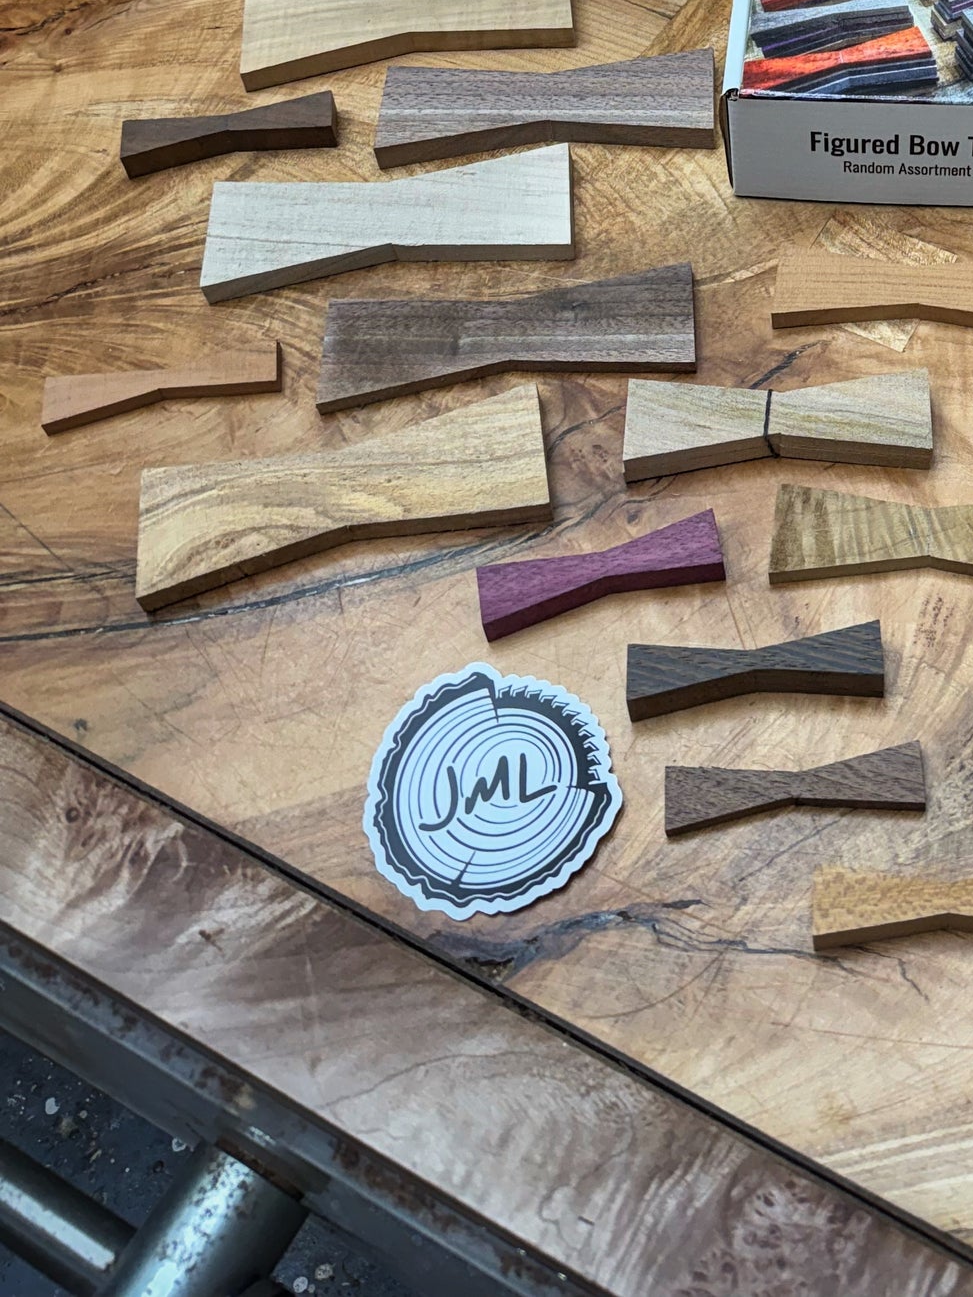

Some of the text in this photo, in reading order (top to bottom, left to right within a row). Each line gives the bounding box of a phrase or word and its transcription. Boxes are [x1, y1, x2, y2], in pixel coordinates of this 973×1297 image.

[811, 132, 899, 156] Figured
[910, 135, 959, 156] Bow
[844, 161, 894, 174] Random
[899, 163, 971, 176] Assortment
